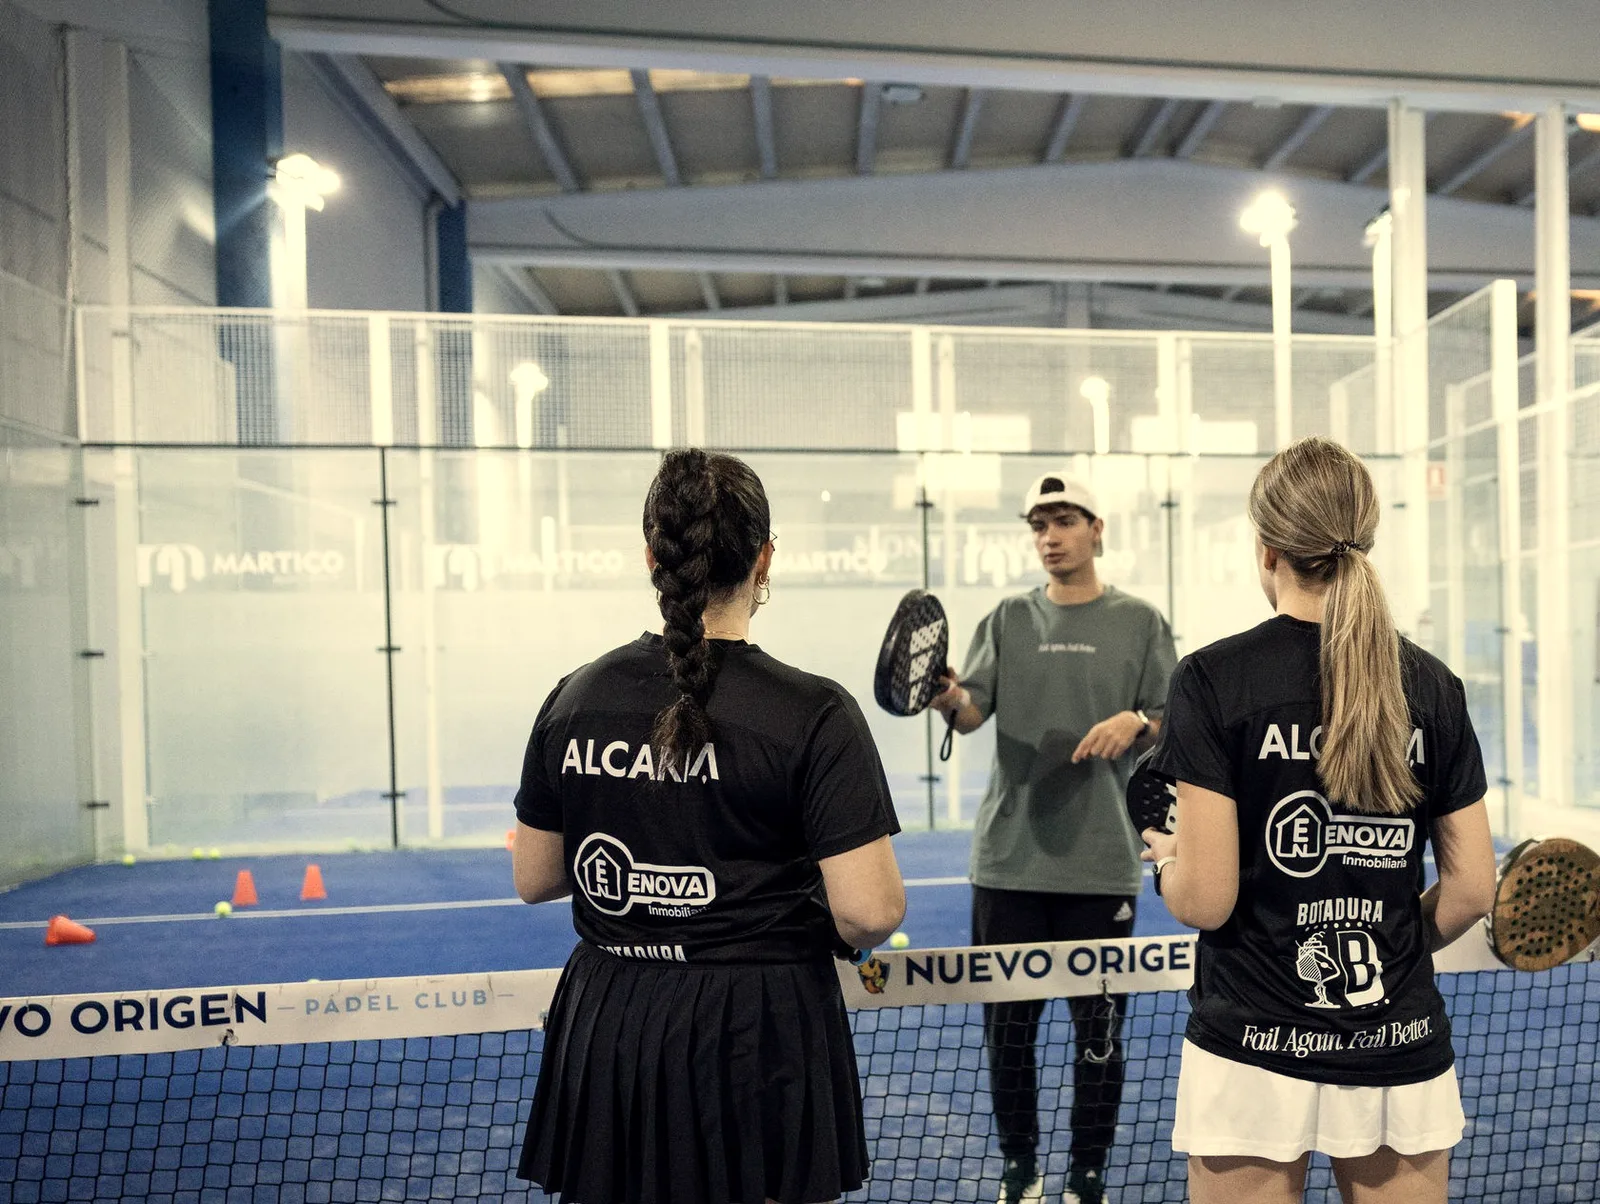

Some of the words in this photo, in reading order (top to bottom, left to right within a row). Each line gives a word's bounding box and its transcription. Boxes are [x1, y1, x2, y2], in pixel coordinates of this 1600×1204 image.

[212, 549, 344, 575] MARTICO
[1324, 824, 1406, 848] ENOVA
[627, 873, 706, 897] ENOVA
[1296, 897, 1384, 926] BOTADURA
[905, 948, 1053, 986] NUEVO
[1067, 941, 1191, 976] ORIGE
[70, 991, 267, 1034] ORIGEN
[414, 989, 488, 1009] CLUB
[1242, 1024, 1281, 1052] Fail
[1282, 1026, 1344, 1058] Again.
[1347, 1024, 1387, 1051] Fail
[1390, 1016, 1433, 1047] Better.
